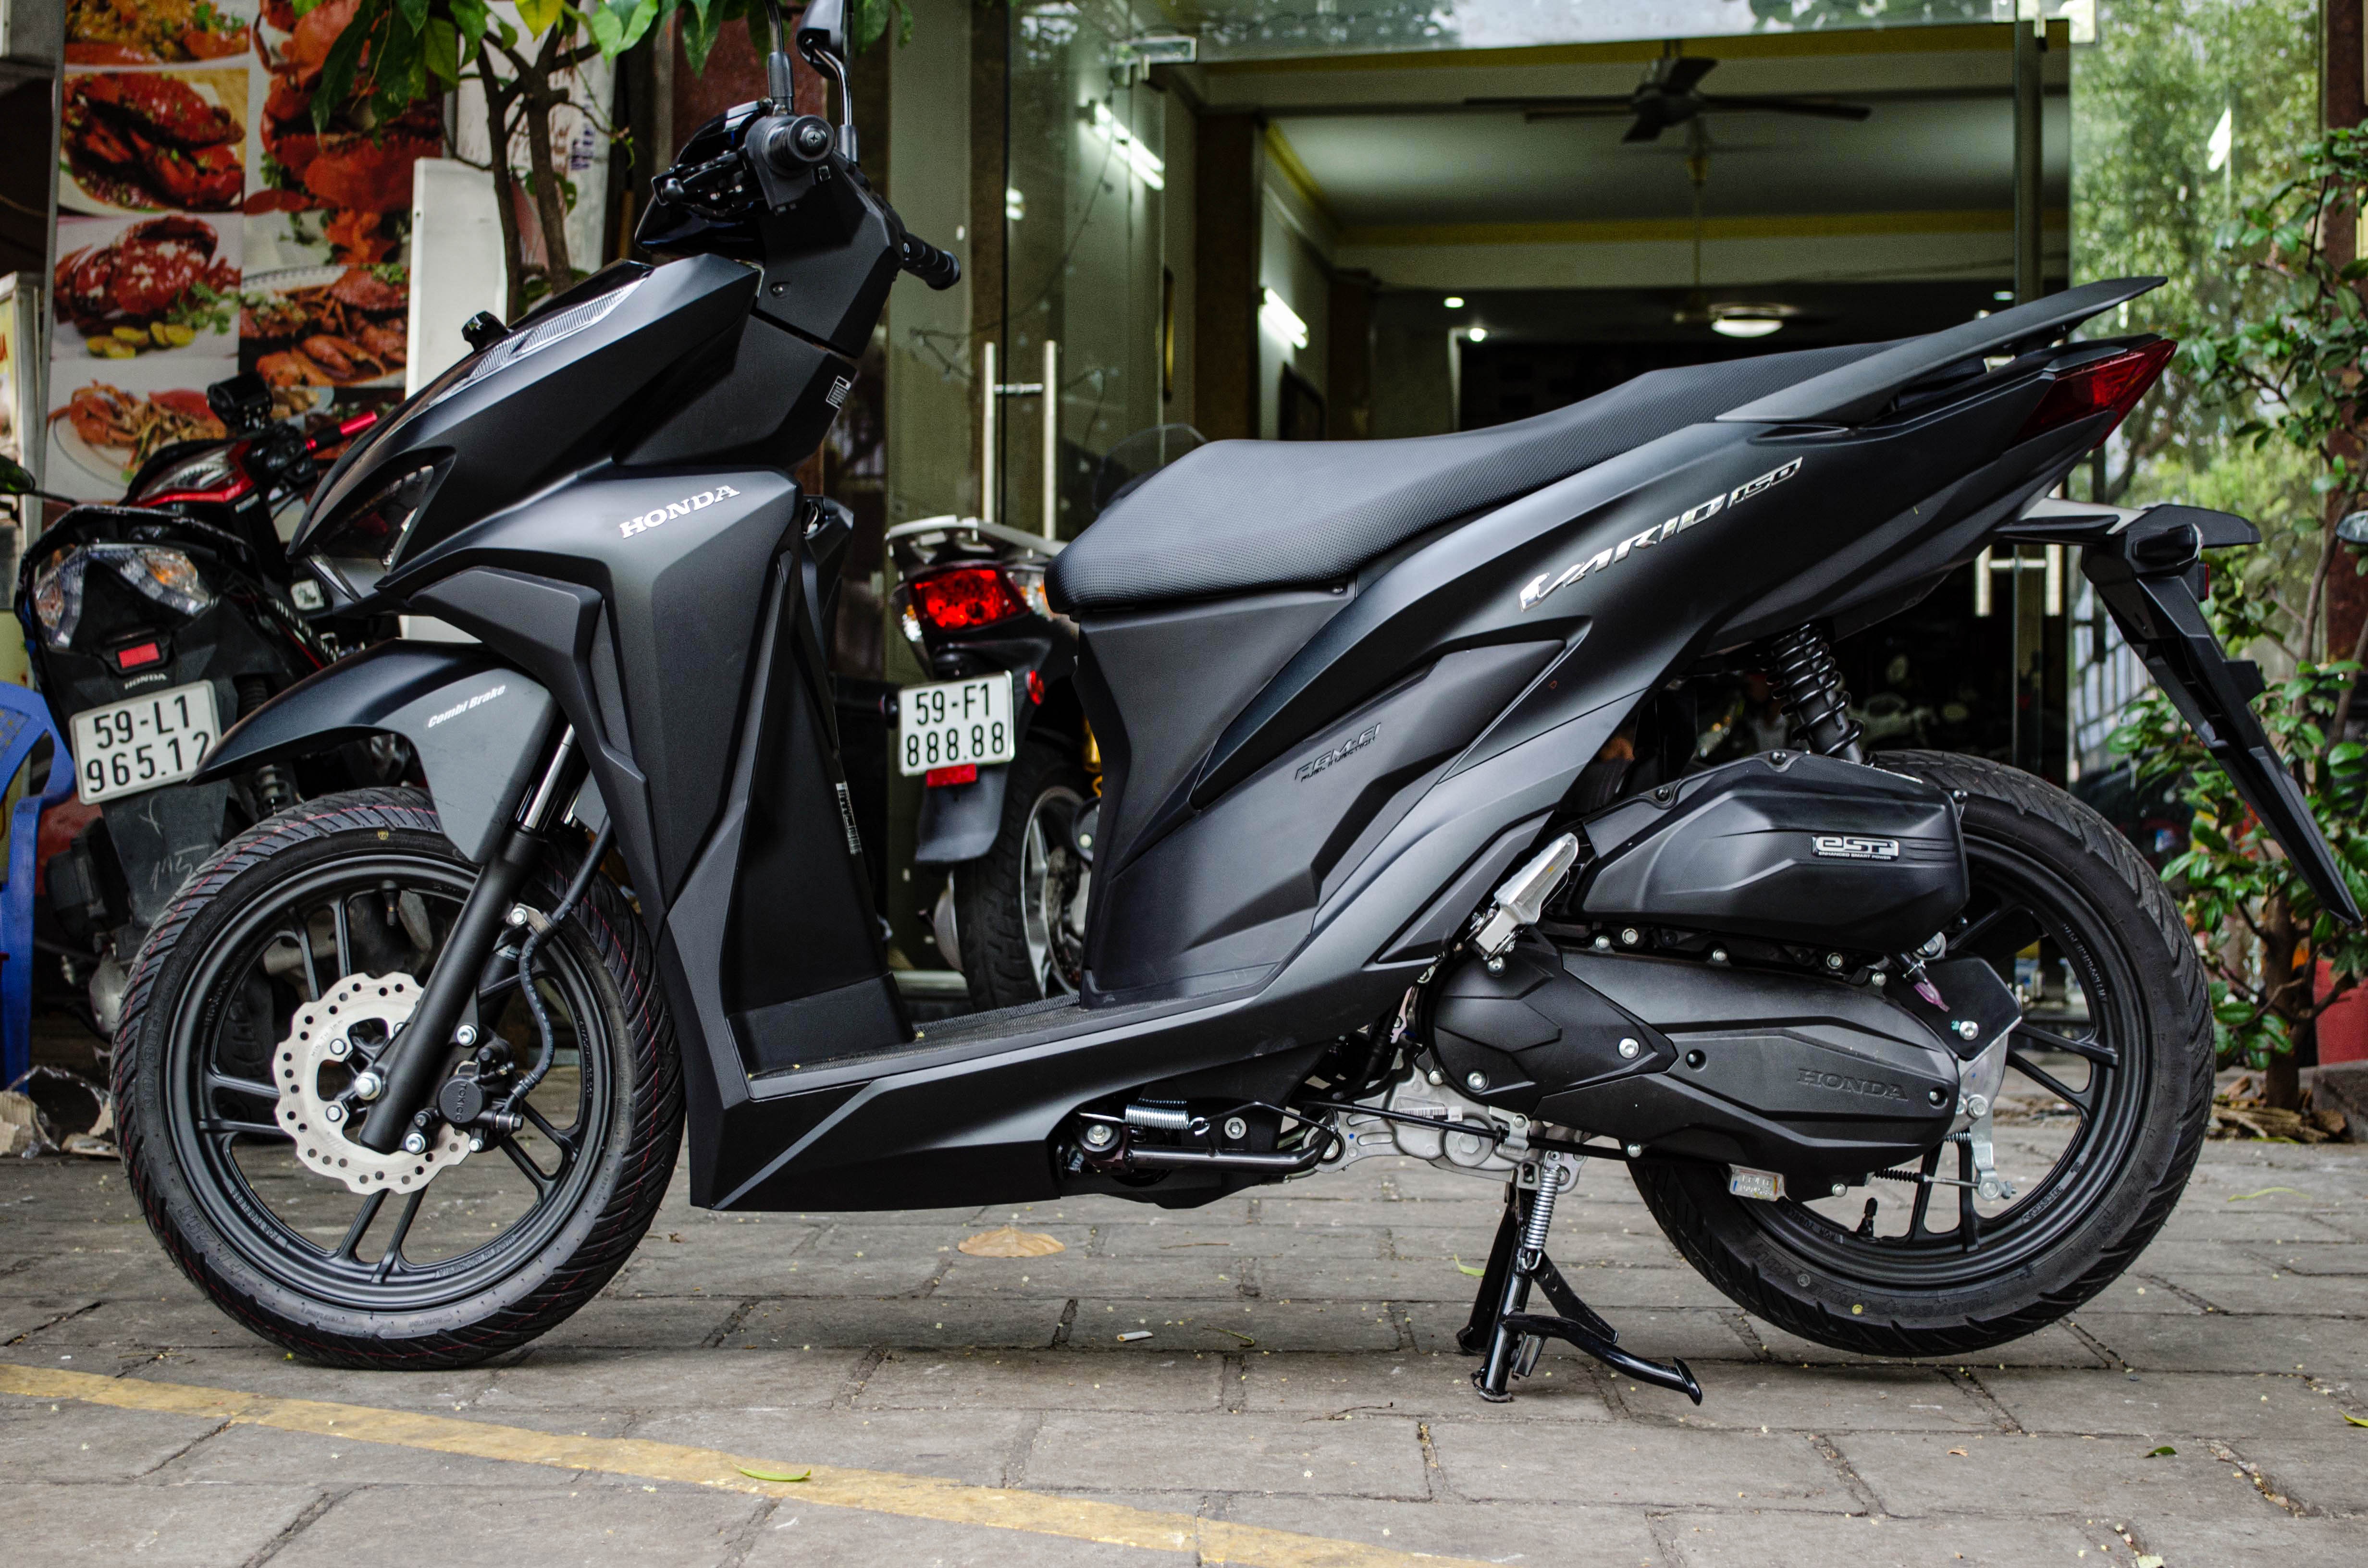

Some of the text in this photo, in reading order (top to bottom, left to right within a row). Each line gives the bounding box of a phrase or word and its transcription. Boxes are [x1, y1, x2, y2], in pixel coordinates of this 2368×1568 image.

[619, 485, 740, 538] HONDA
[1518, 456, 1802, 612] VARIO 150
[124, 673, 167, 690] HONDA
[916, 683, 989, 725] 59-F1
[94, 695, 189, 749] 59-L1
[428, 685, 506, 728] Combi Brake
[86, 731, 210, 793] 965.12
[907, 722, 1003, 767] 888.88
[1301, 736, 1376, 783] FUEL INJECTION
[456, 1083, 468, 1121] TOKICO
[1798, 1068, 1908, 1102] HONDA
[231, 1188, 280, 1240] FOR TUBELESS
[2023, 1185, 2063, 1220] HONDA
